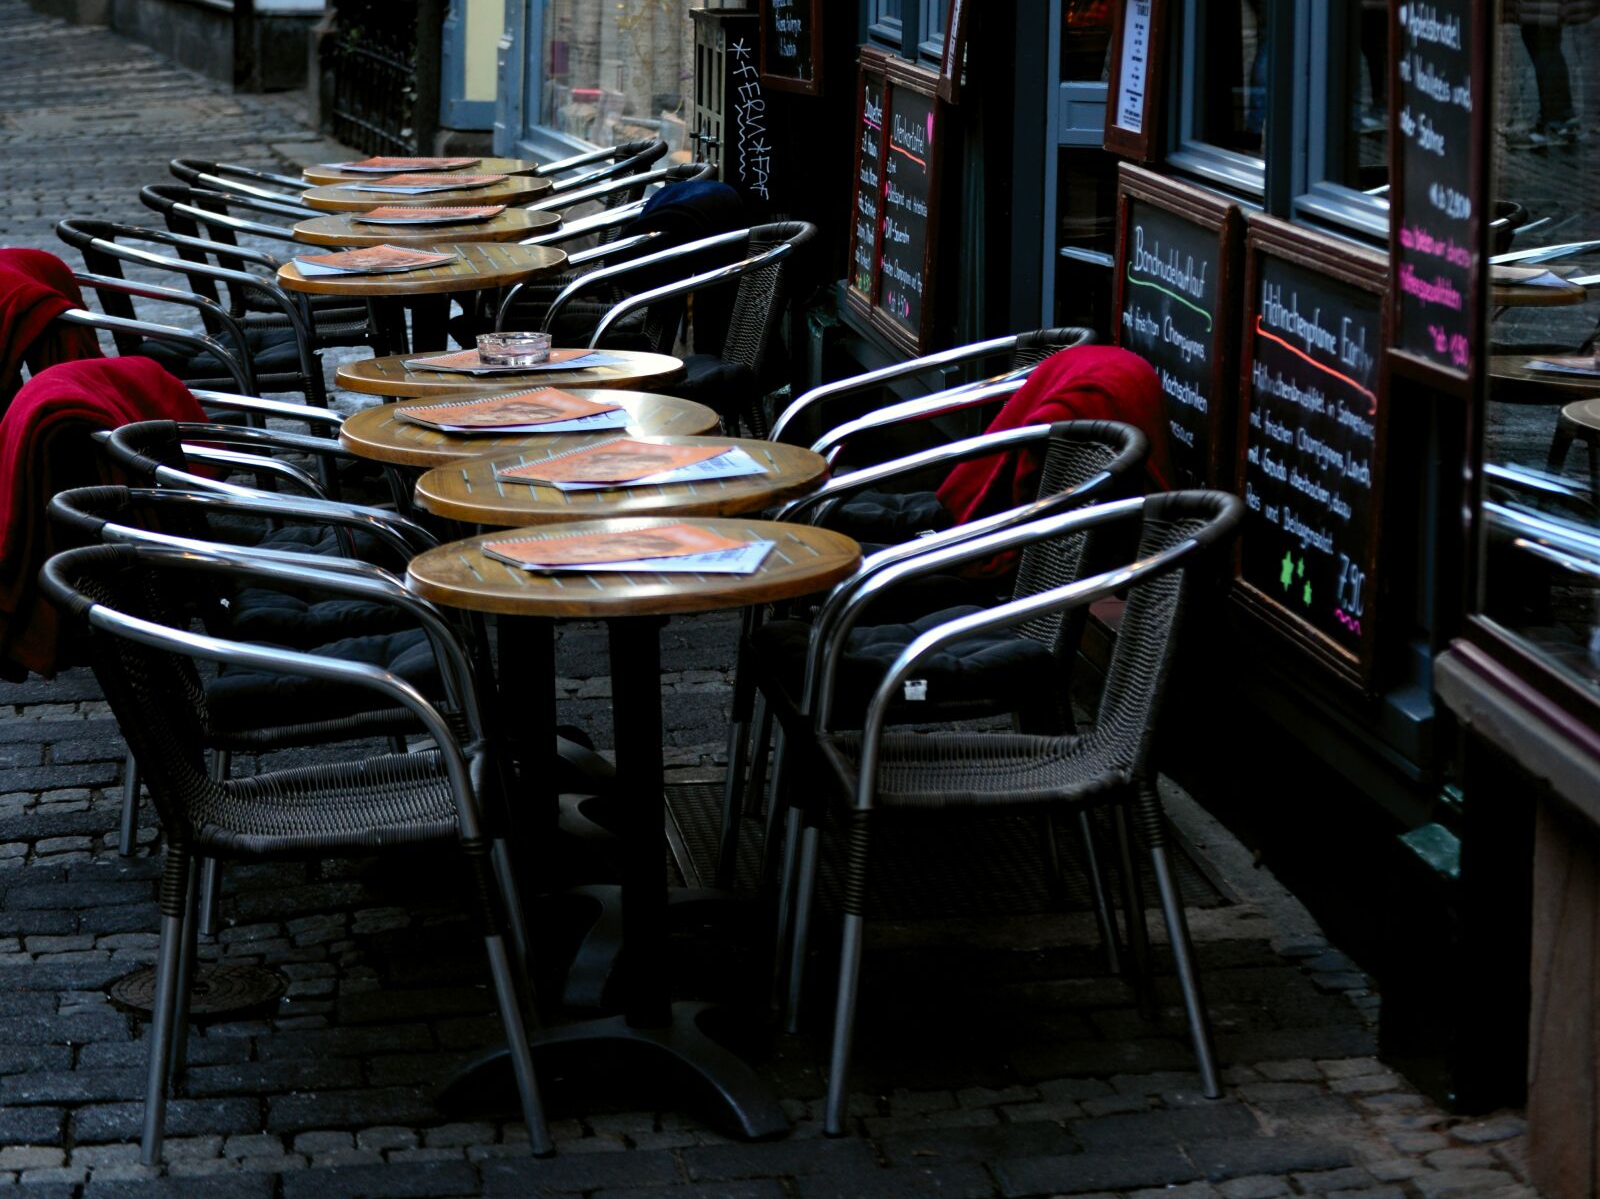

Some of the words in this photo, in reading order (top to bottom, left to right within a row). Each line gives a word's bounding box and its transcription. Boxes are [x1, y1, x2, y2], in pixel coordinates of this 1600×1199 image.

[1133, 225, 1207, 298] Bandnudelauflauf
[1340, 315, 1374, 388] Early
[1162, 368, 1208, 415] Kochschinken
